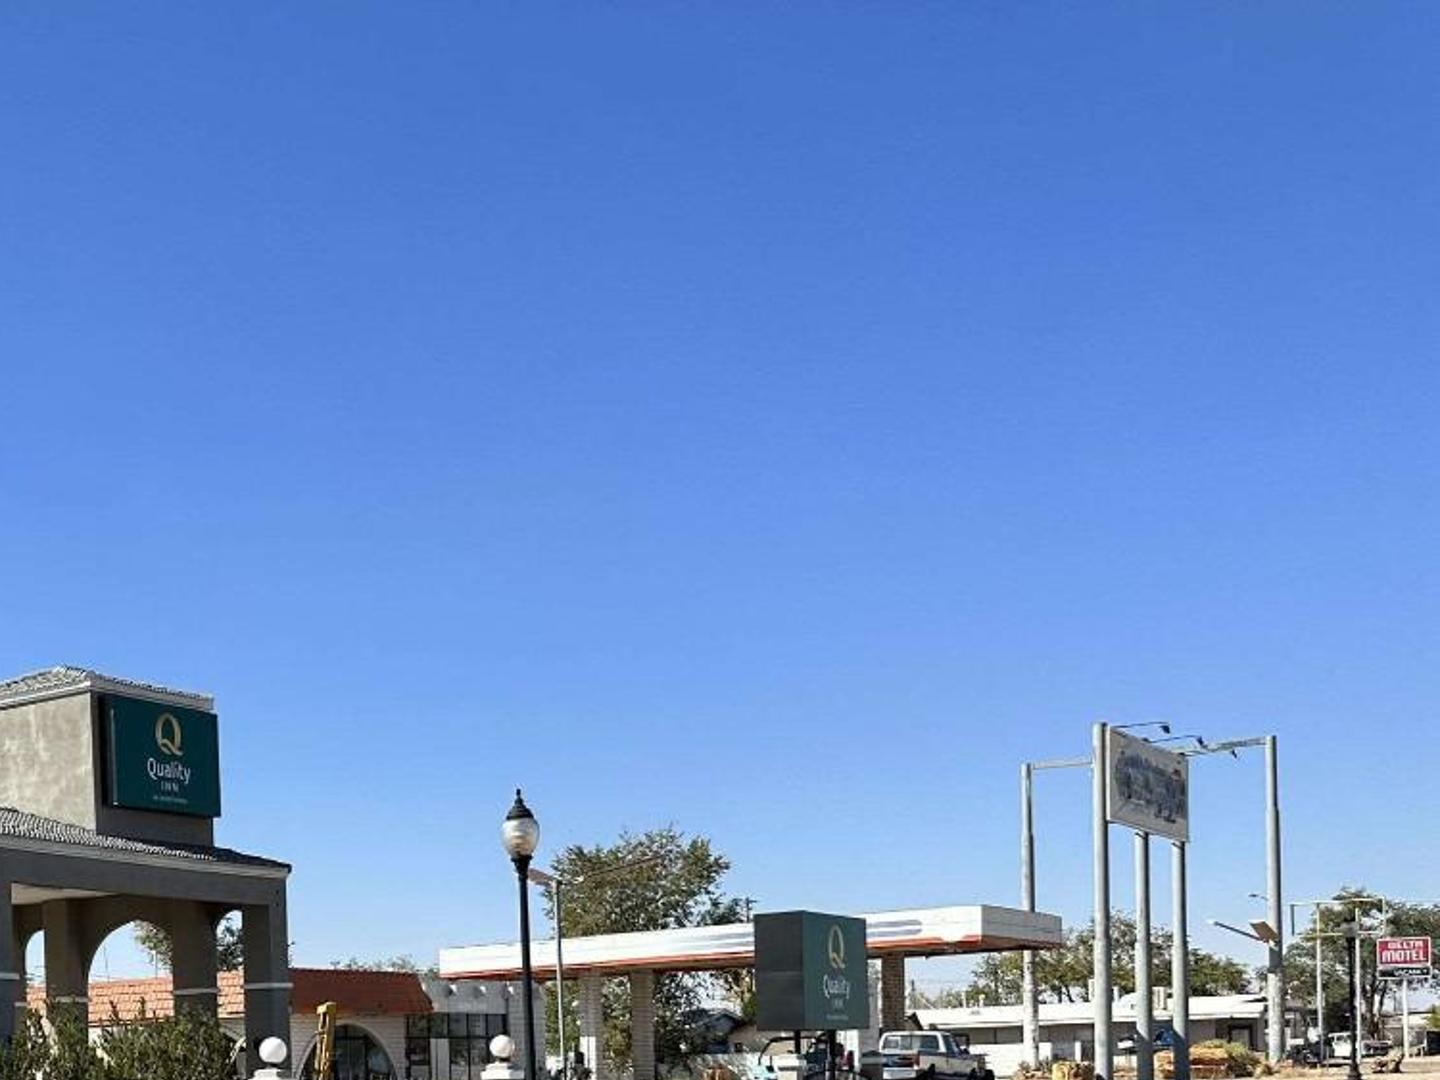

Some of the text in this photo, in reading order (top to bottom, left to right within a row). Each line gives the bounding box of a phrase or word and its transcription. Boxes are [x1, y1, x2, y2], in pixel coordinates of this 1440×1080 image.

[155, 713, 183, 756] Q
[147, 758, 191, 784] Quality
[1382, 949, 1427, 963] MOTEL
[823, 974, 851, 999] Quality
